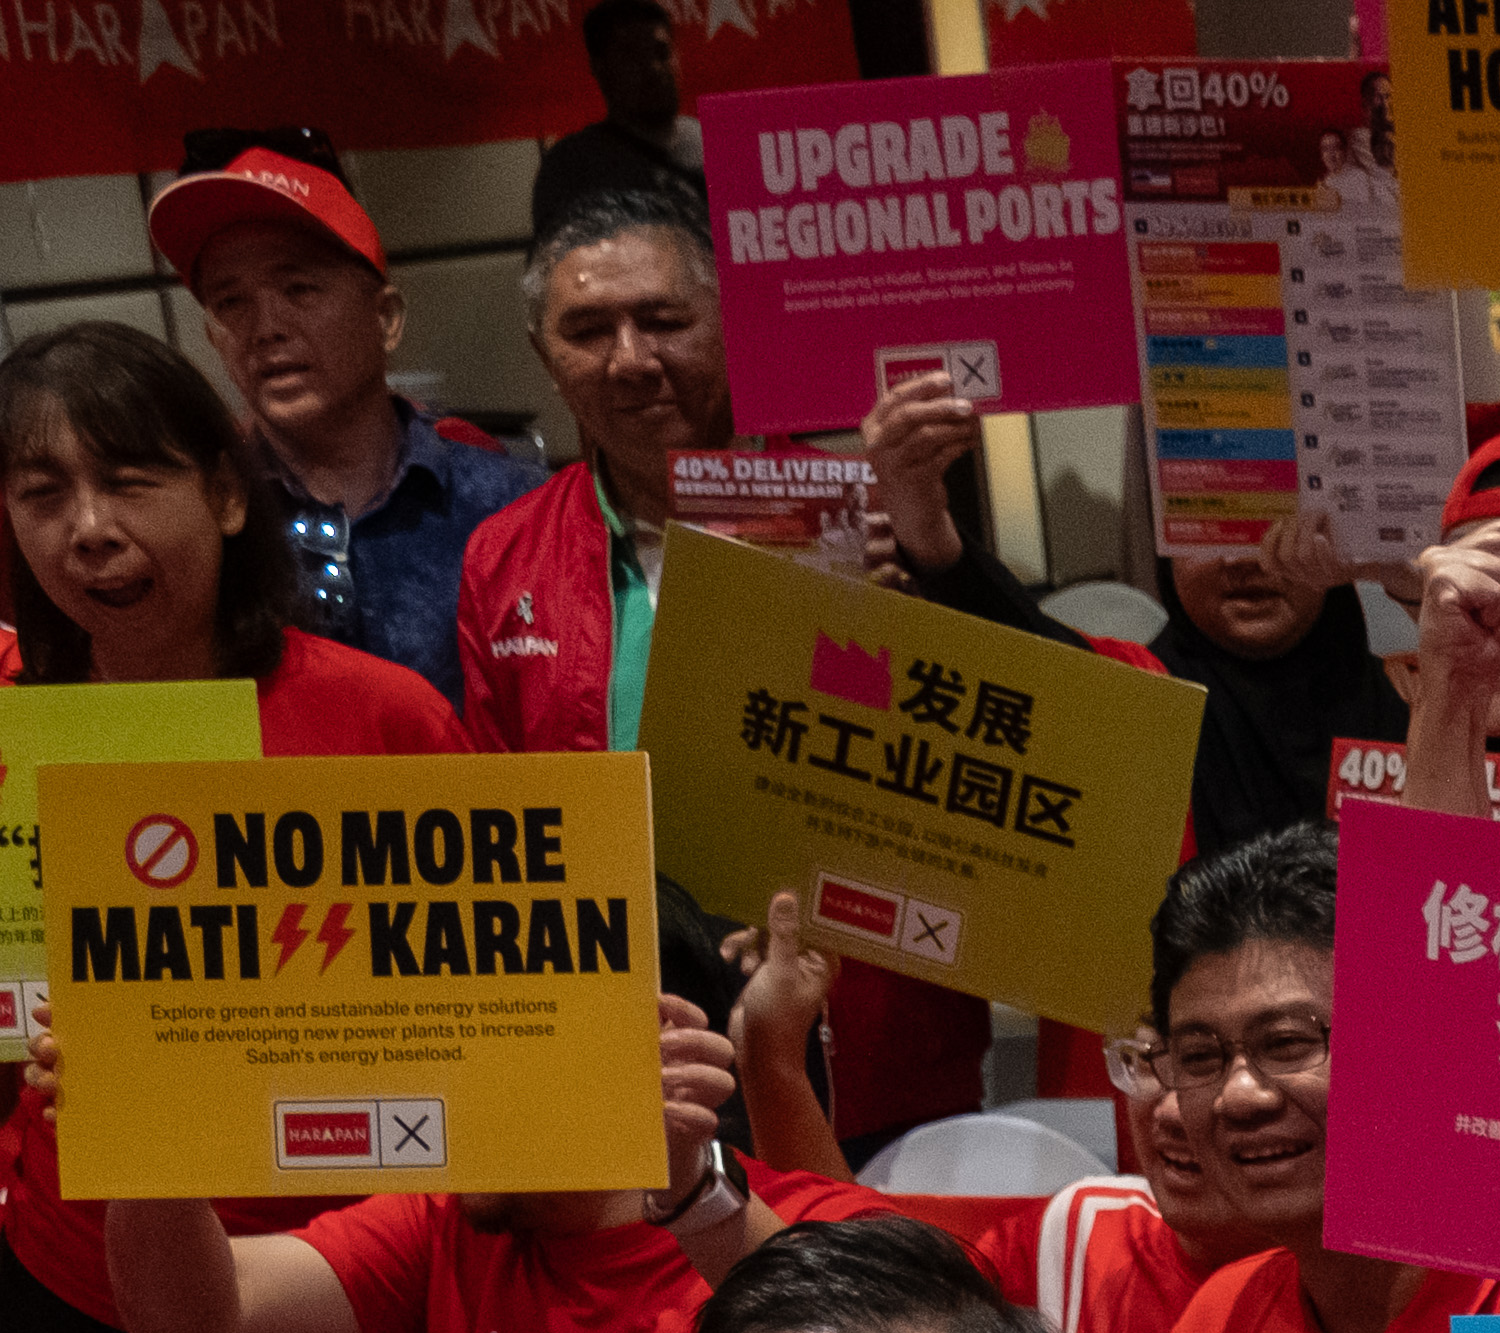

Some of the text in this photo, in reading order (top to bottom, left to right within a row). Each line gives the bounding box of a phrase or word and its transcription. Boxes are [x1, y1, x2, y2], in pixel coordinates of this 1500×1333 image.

[758, 112, 1014, 195] UPGRADE
[728, 178, 1121, 265] REGIONAL PORTS
[673, 459, 729, 482] 40%
[900, 658, 1036, 755] 发展
[740, 688, 1082, 849] 新工业园区
[213, 807, 566, 889] NO MORE
[70, 903, 260, 983] MATI
[369, 897, 630, 978] KARAN
[149, 998, 557, 1023] Explore green and sustainable energy solutions
[288, 1123, 367, 1145] HARAPAN
